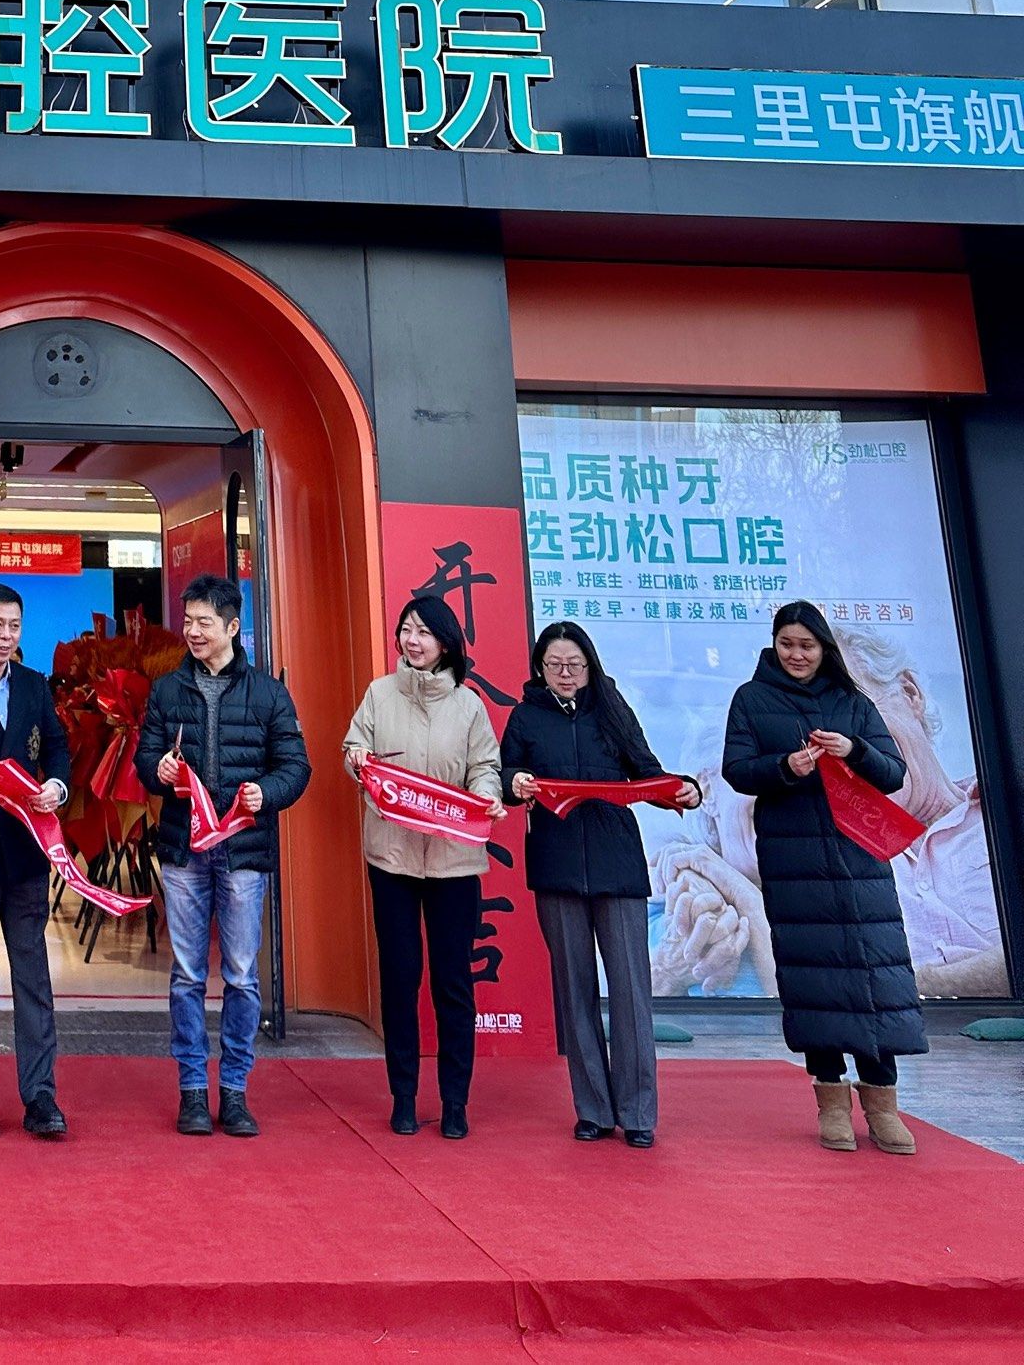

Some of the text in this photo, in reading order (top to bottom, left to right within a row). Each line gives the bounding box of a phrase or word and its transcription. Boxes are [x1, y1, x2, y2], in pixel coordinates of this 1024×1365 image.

[679, 84, 1024, 156] 三里屯旗舰
[848, 442, 907, 458] 劲松口腔
[520, 451, 722, 505] 品质种牙
[399, 786, 468, 820] 劲松口腔
